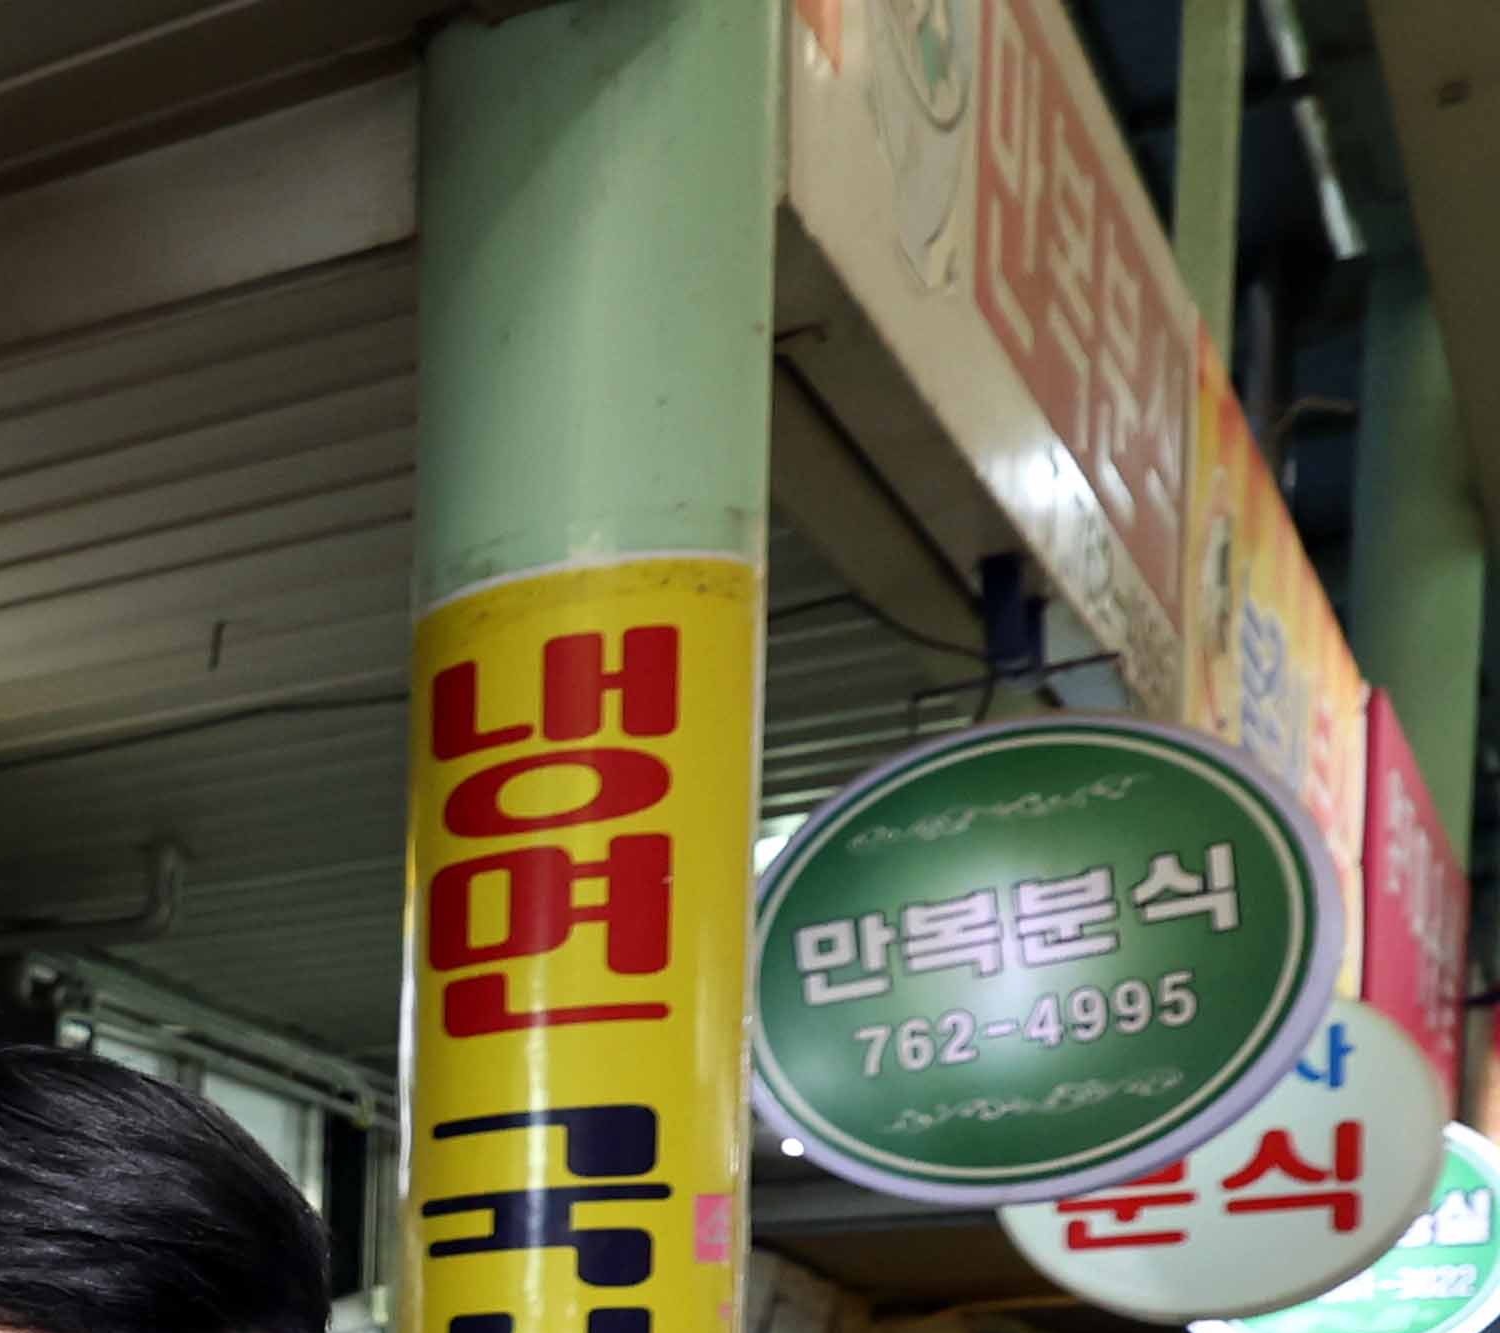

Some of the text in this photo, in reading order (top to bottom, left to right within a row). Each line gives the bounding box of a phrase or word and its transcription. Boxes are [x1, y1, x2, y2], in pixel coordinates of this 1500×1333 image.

[430, 624, 679, 1038] 냉면
[793, 840, 1241, 1007] 만복분식
[853, 970, 1200, 1079] 762-4995
